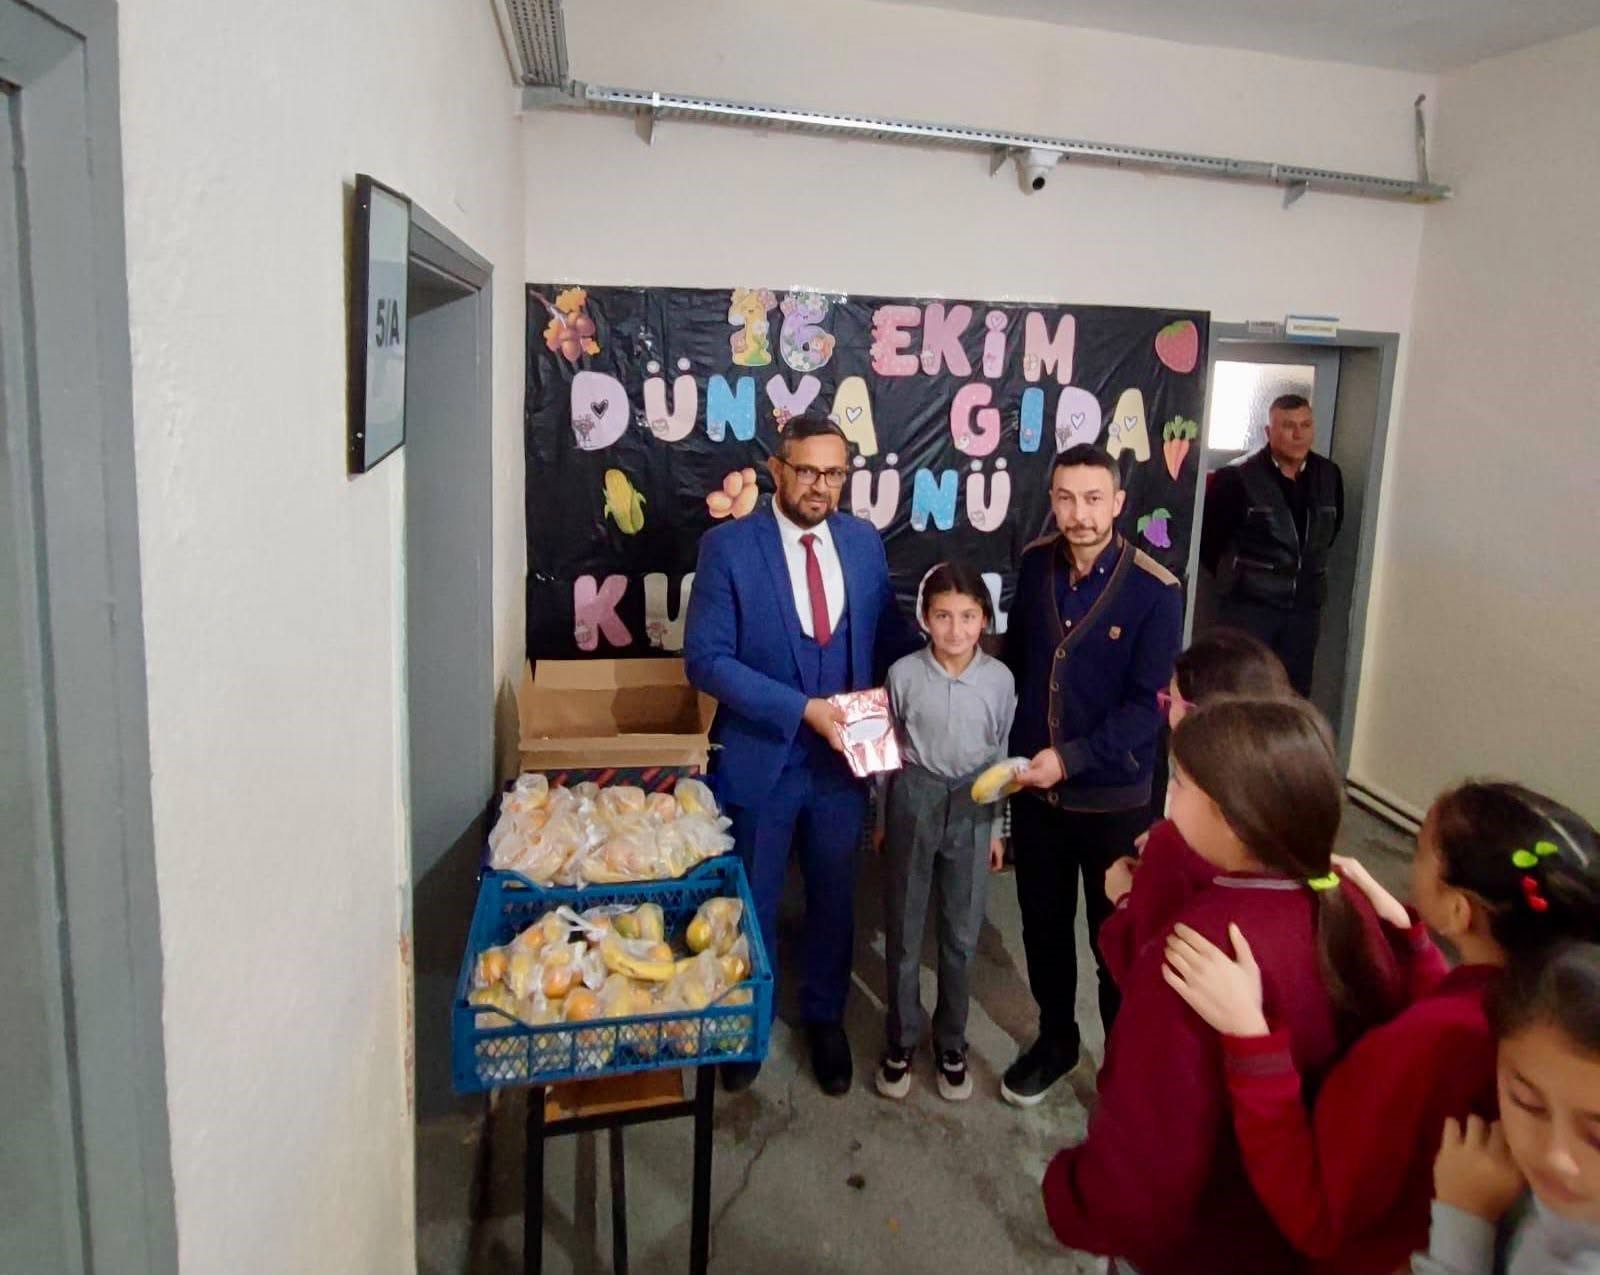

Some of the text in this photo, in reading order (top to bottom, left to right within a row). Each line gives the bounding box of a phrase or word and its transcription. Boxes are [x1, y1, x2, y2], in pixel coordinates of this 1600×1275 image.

[376, 298, 399, 347] 5/A
[728, 286, 1077, 385] 16 EKİM
[570, 357, 1150, 462] DÜNYA GIDA
[852, 452, 1011, 532] ÜNÜ
[574, 571, 697, 652] KU
